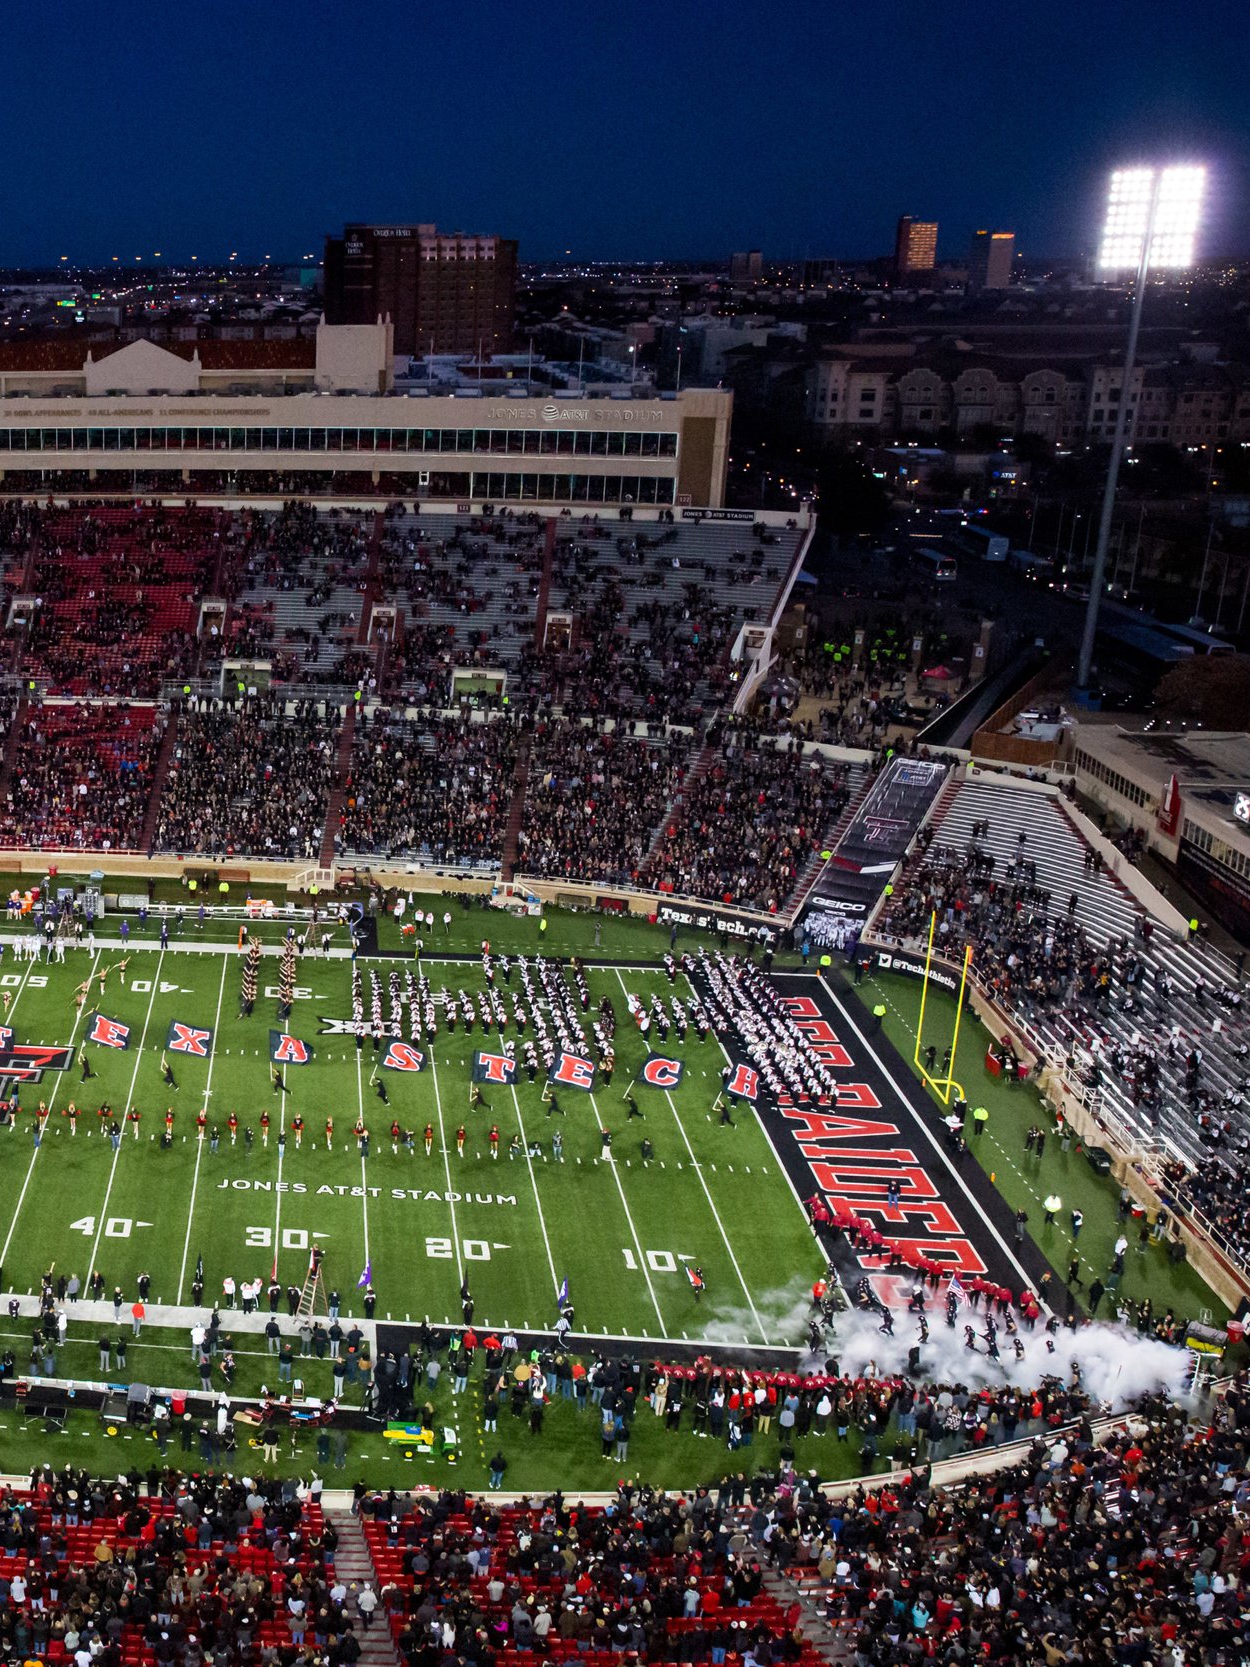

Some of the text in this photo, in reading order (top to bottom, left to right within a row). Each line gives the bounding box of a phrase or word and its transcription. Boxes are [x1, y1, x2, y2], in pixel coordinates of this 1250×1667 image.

[169, 408, 211, 416] CONFERENCE
[213, 408, 270, 416] CHAMPIONSHIPS
[487, 408, 663, 422] JONES AT&T STADIUM
[896, 757, 946, 770] GEICO
[812, 896, 866, 912] GEICO
[0, 974, 49, 988] 50
[131, 979, 180, 993] 40
[90, 1015, 130, 1049] E
[169, 1022, 210, 1057] X
[273, 1033, 308, 1064] A
[383, 1041, 424, 1073] S
[478, 1052, 516, 1084] T
[553, 1053, 595, 1089] E
[643, 1058, 681, 1087] C
[726, 1063, 761, 1100] H
[216, 1179, 519, 1206] JONES AT&T STADIUM
[69, 1215, 133, 1239] 40
[245, 1226, 309, 1250] 30
[425, 1237, 491, 1261] 20
[621, 1248, 678, 1272] 10
